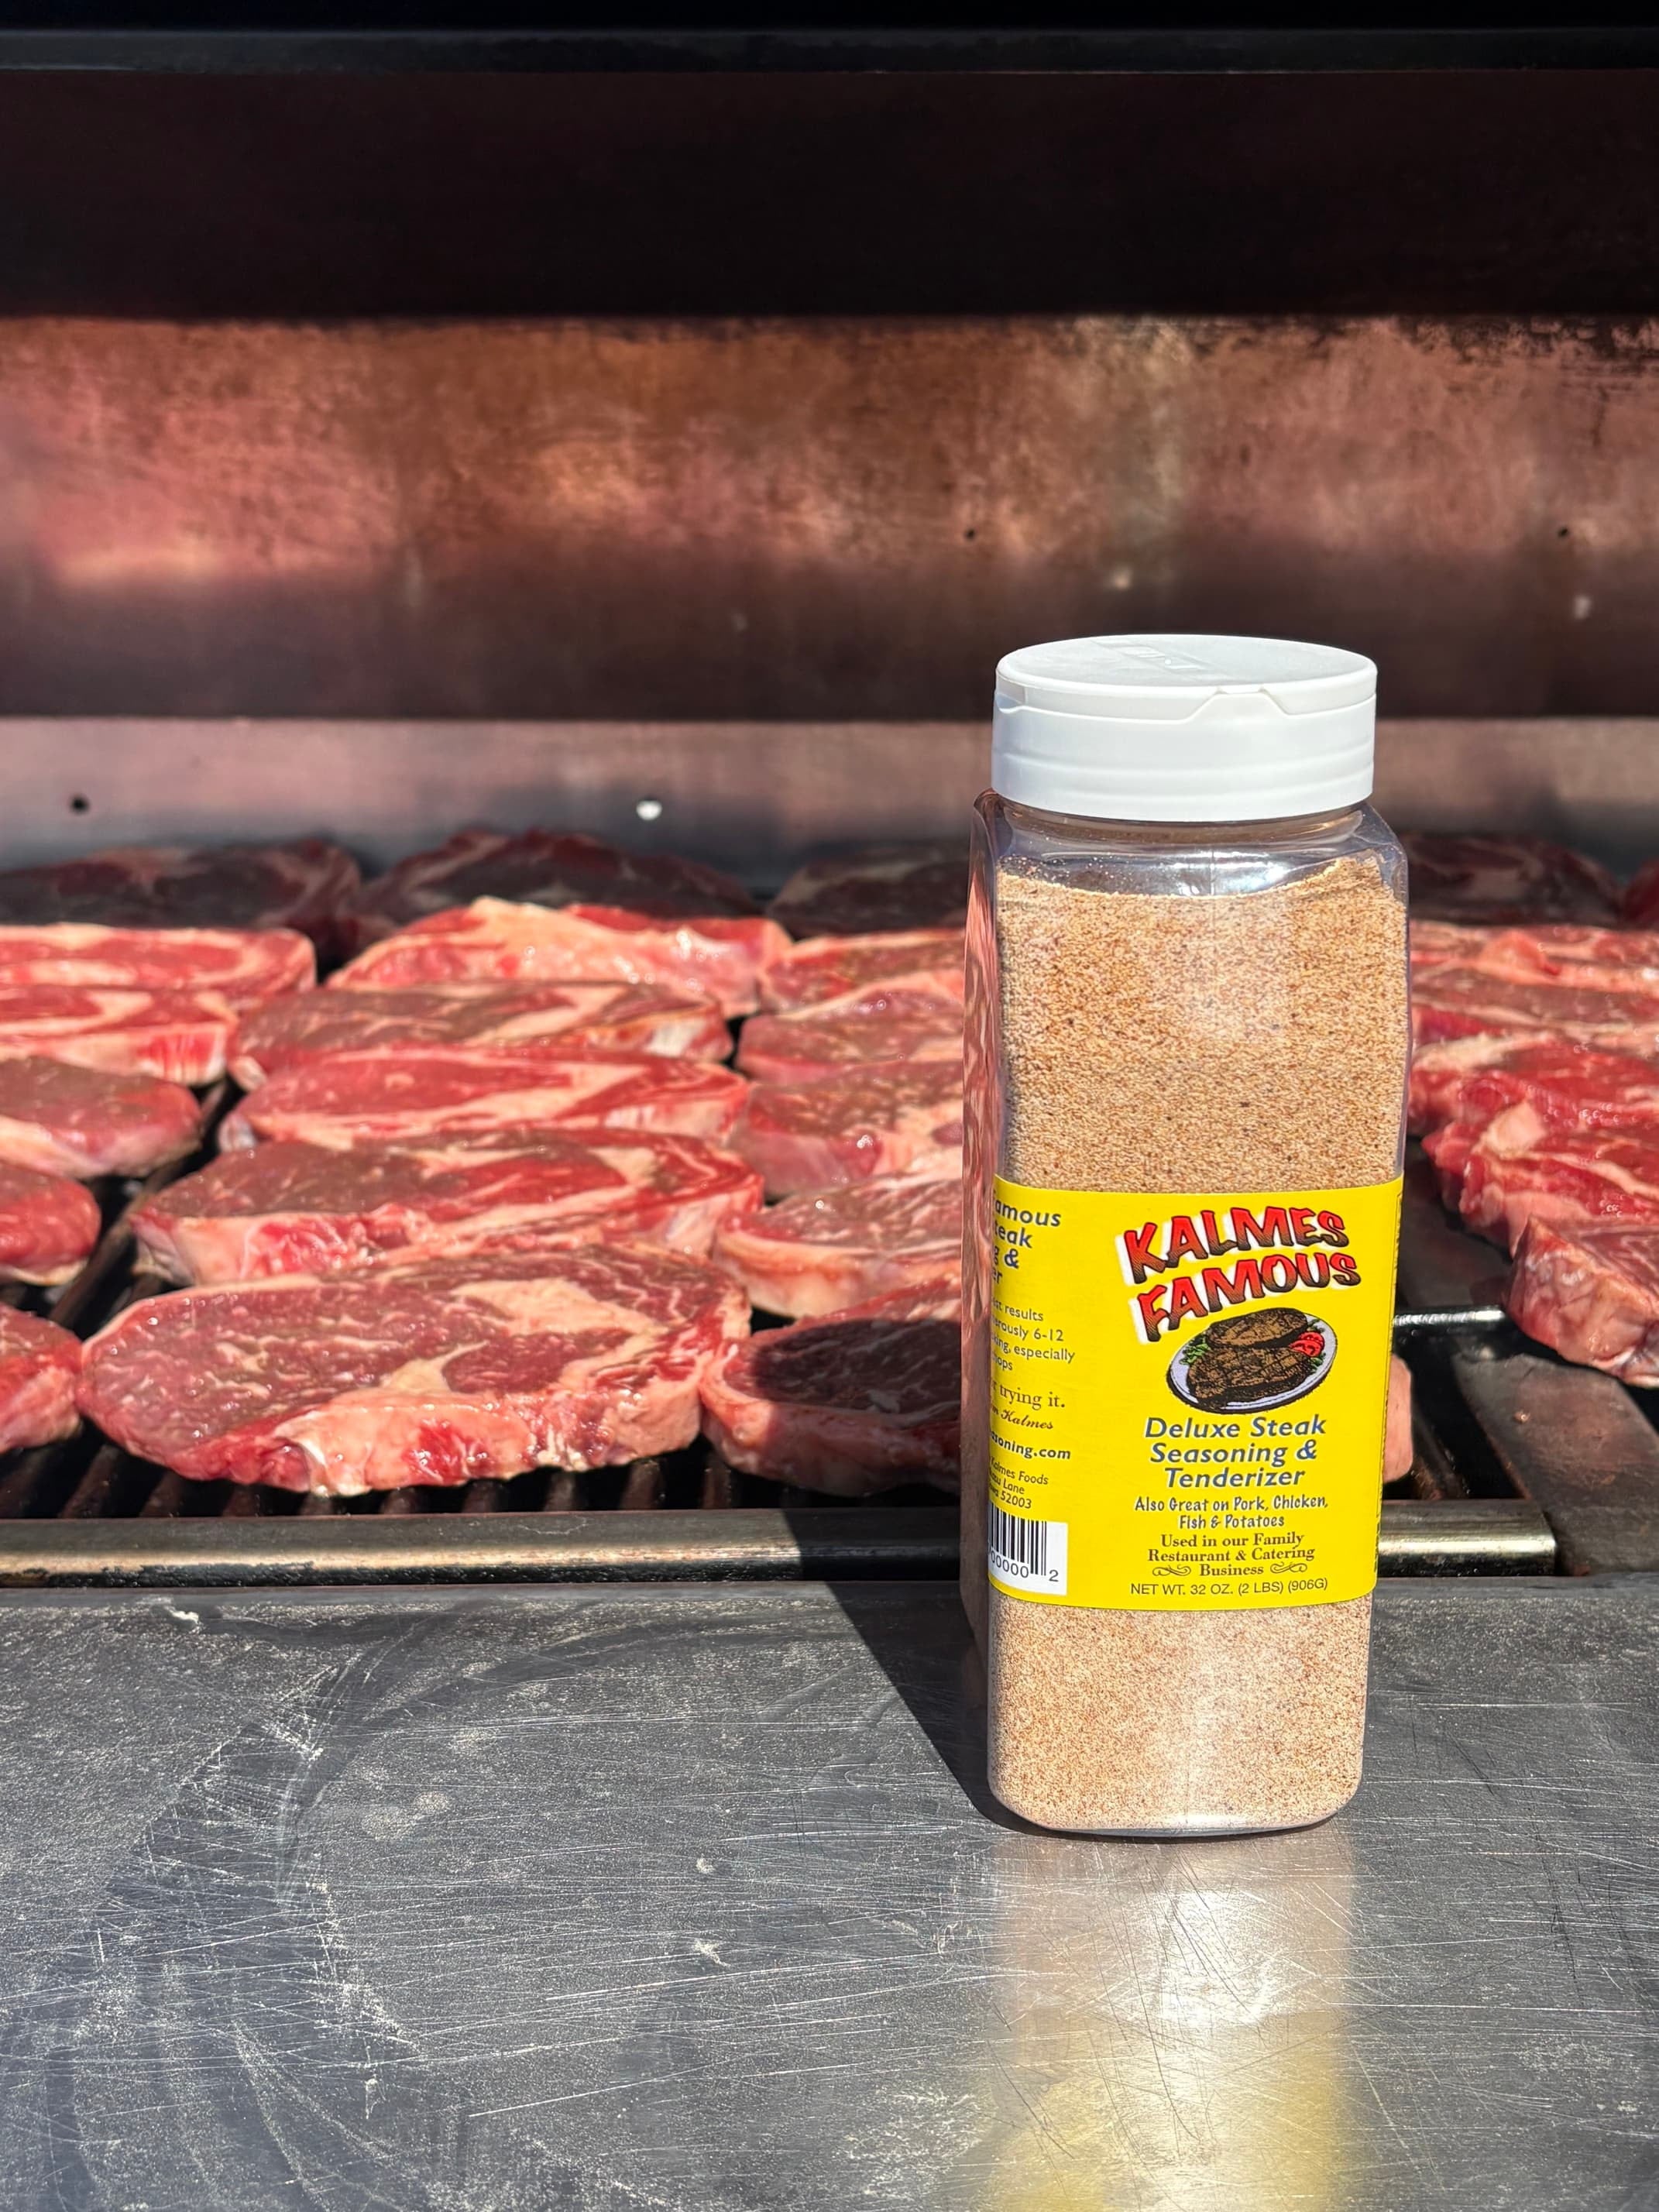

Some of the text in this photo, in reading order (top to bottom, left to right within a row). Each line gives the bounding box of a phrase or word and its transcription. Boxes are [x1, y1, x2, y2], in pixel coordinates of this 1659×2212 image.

[994, 1200, 1061, 1227] amous
[994, 1221, 1032, 1249] teak
[1122, 1206, 1349, 1284] KALMES
[1004, 1249, 1019, 1269] &
[1135, 1252, 1362, 1342] FAMOUS
[1005, 1305, 1043, 1321] results
[1033, 1328, 1064, 1341] 6-12
[1014, 1345, 1075, 1364] especially
[1000, 1385, 1042, 1410] trying
[1047, 1391, 1066, 1407] it.
[1001, 1410, 1053, 1429] Kalmes
[1145, 1414, 1326, 1438] Deluxe Steak
[1150, 1439, 1317, 1468] Seasoning &
[1003, 1479, 1025, 1494] Lane
[1018, 1471, 1049, 1485] Foods
[1164, 1467, 1306, 1488] Tenderizer
[1001, 1491, 1032, 1509] 52003
[1135, 1493, 1328, 1511] Also Great on Pork, Chicken,
[1179, 1514, 1284, 1529] Fish & Potatoes
[1161, 1531, 1304, 1548] Used in our Family
[1148, 1547, 1315, 1561] Restaurant & Catering
[1049, 1569, 1059, 1582] 2
[1200, 1564, 1264, 1576] Business
[1131, 1578, 1328, 1596] NET WT. 32 OZ. (2 LBS) (906G)
